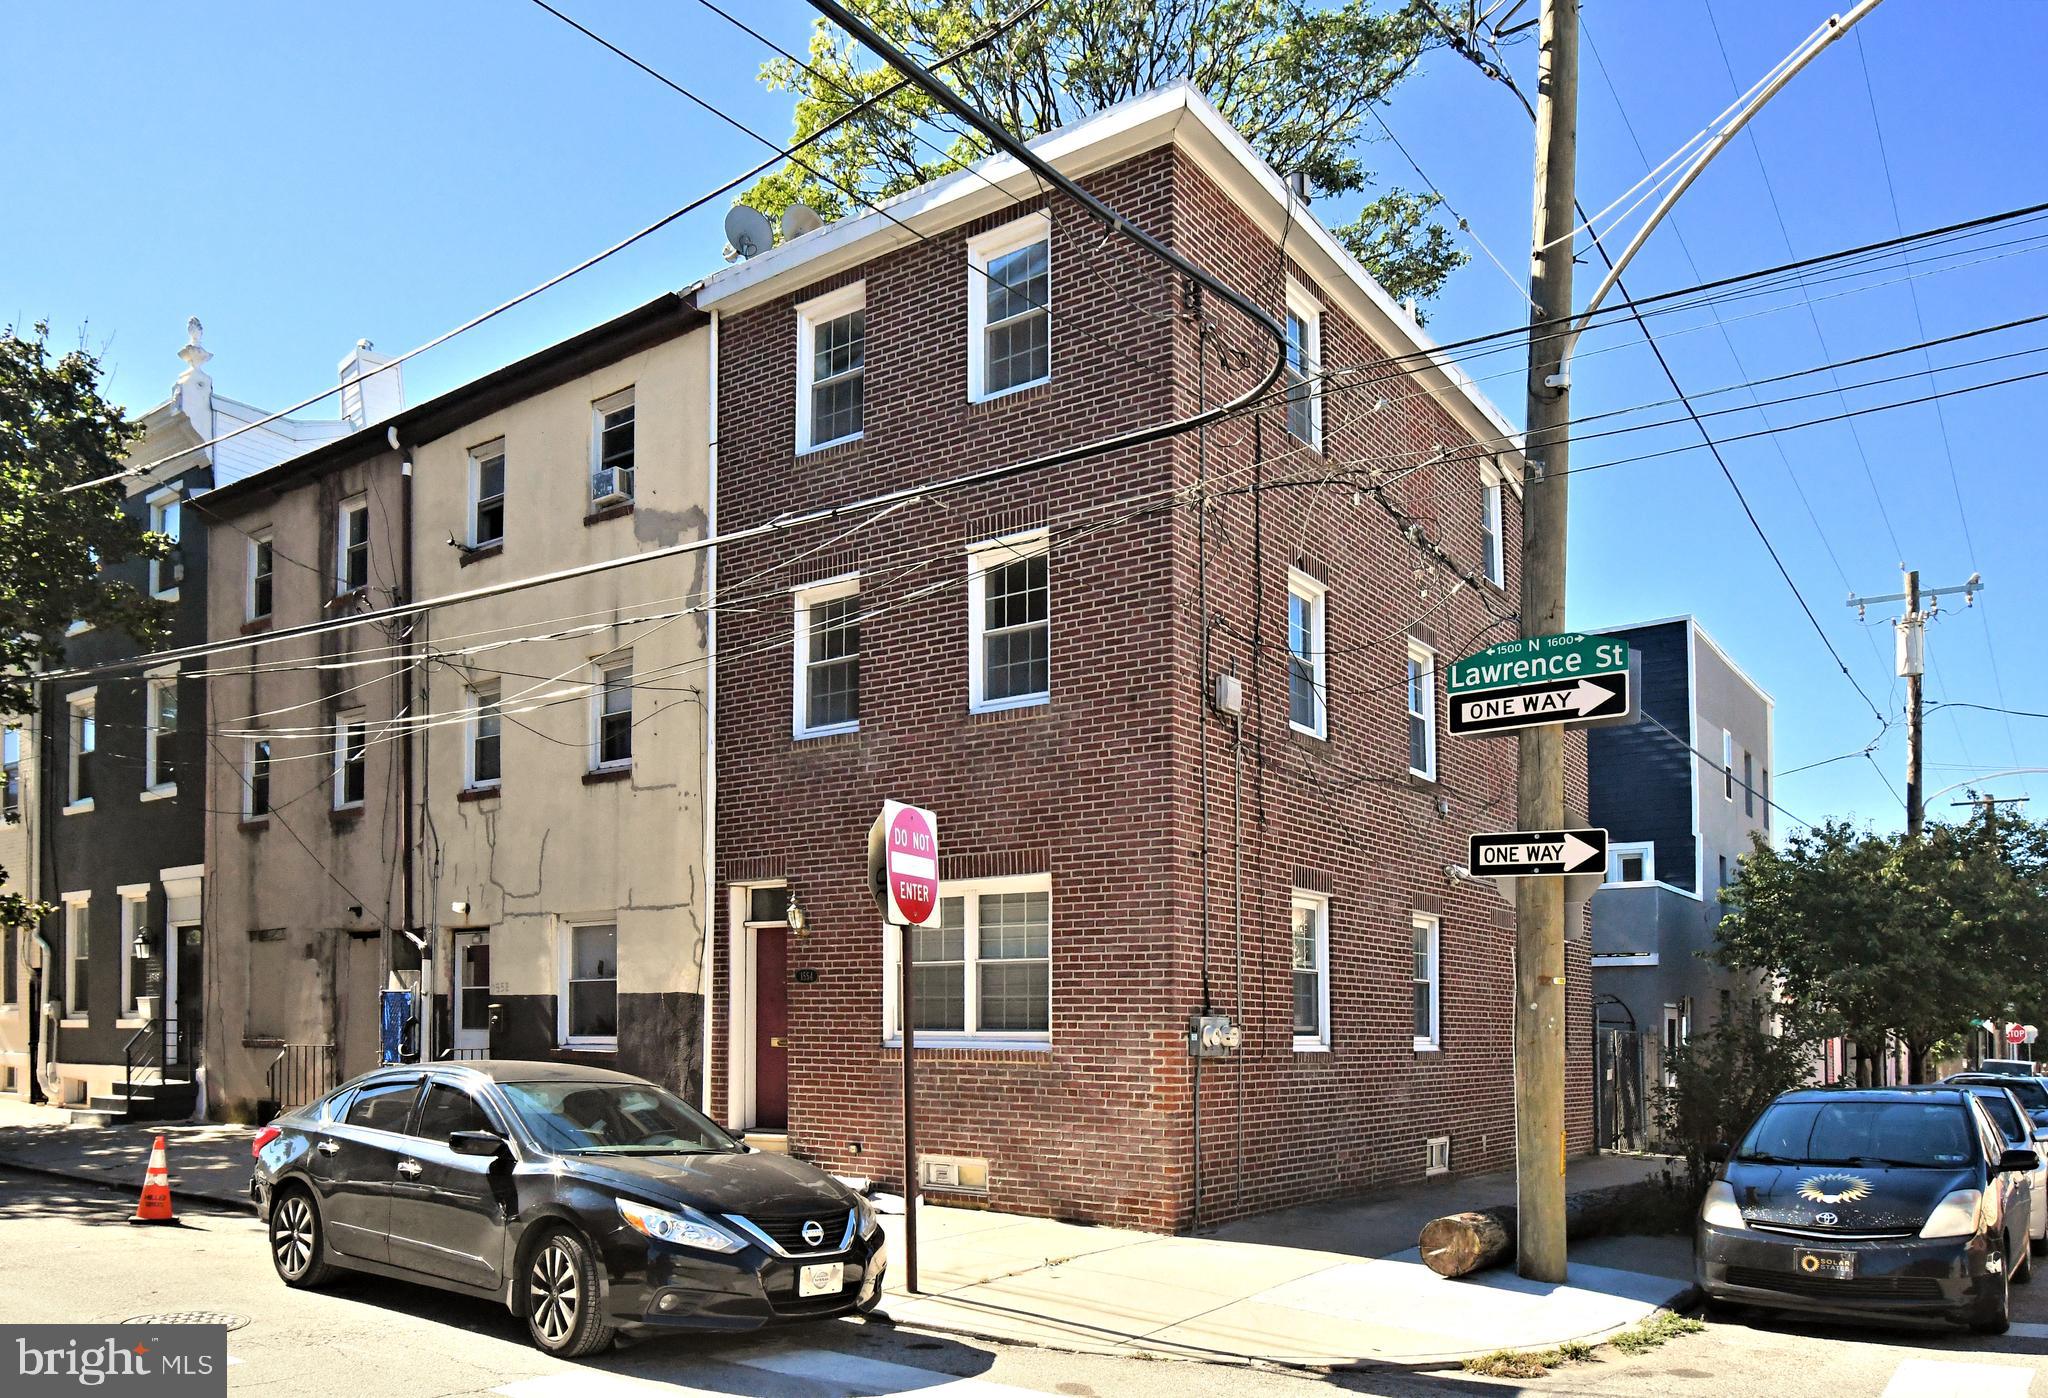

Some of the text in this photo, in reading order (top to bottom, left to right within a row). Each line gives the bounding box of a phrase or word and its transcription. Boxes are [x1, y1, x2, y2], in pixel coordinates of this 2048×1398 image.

[1497, 635, 1574, 655] 1500 N 1600
[1451, 644, 1624, 688] Lawrence St
[1470, 691, 1572, 719] ONE WAY
[895, 828, 930, 852] DO NOT
[1484, 845, 1564, 863] ONE WAY
[900, 881, 929, 902] ENTER
